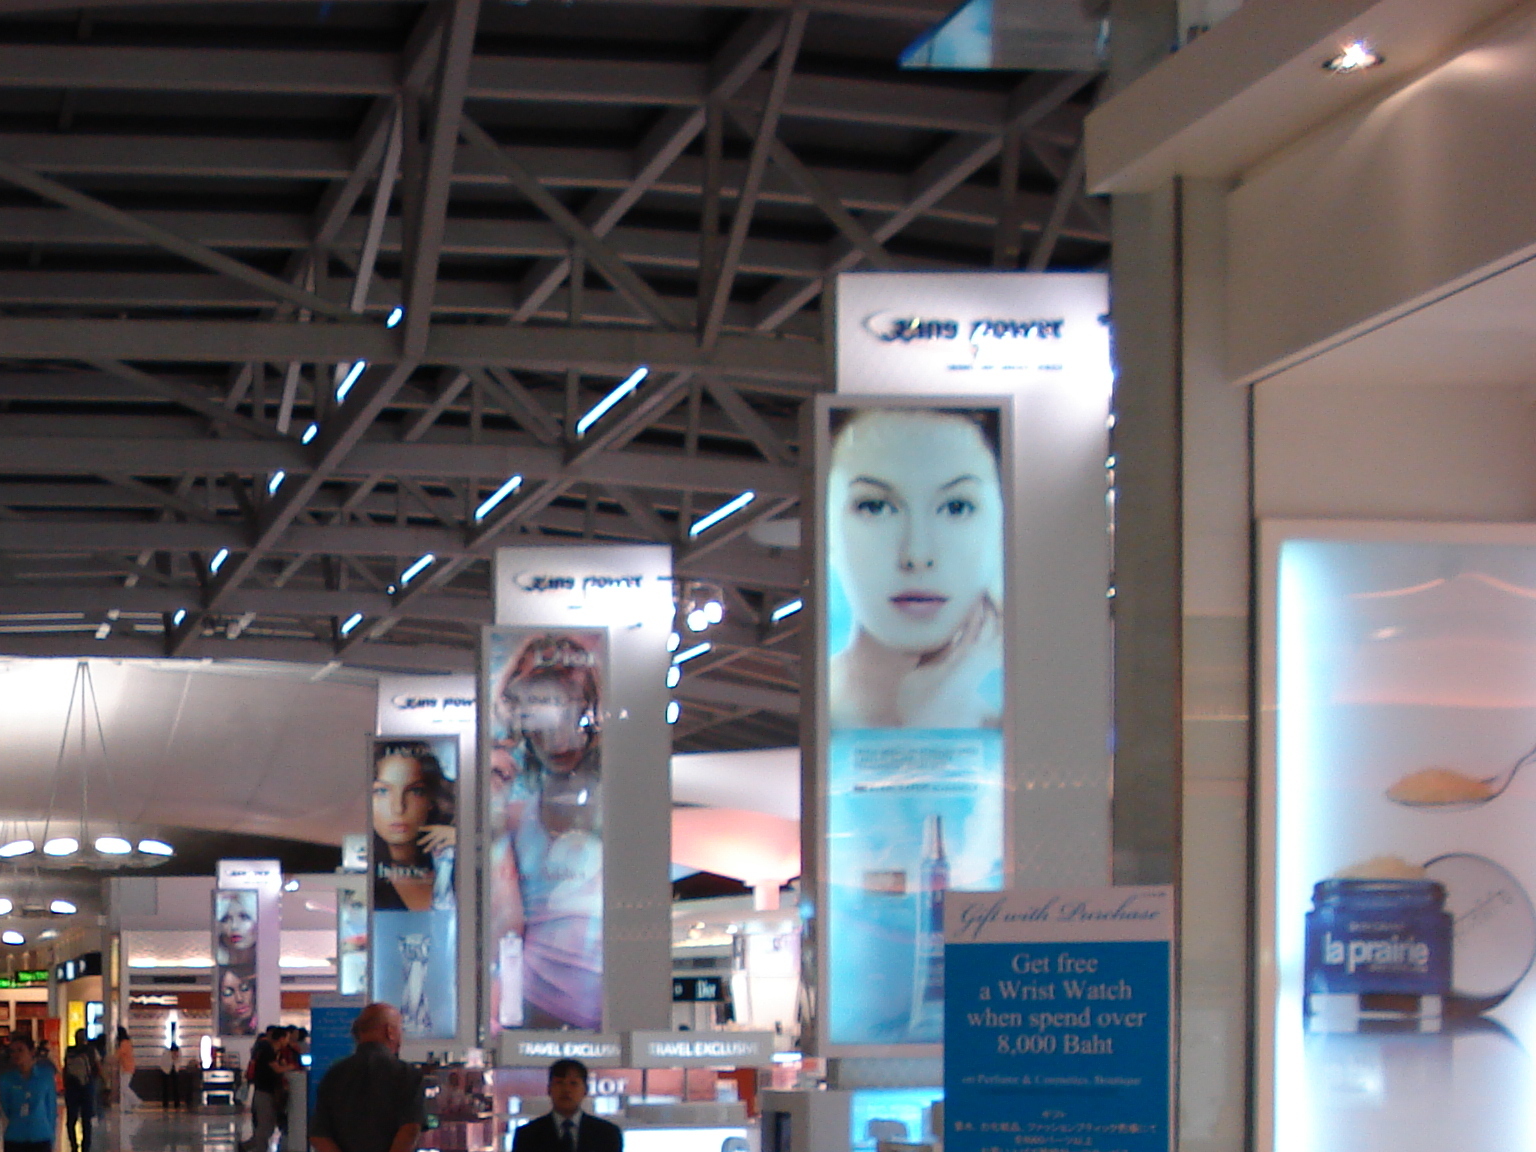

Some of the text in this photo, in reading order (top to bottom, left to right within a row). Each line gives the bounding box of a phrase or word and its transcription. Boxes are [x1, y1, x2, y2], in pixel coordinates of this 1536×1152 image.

[954, 893, 1161, 939] Gift with Purchase
[1011, 952, 1099, 974] Get free
[1323, 931, 1430, 974] la prairie
[979, 979, 1133, 1001] a Wrist Watch
[967, 1006, 1147, 1033] when spend over
[519, 1041, 561, 1058] TRAVEL
[997, 1034, 1114, 1056] 8,000 Baht
[588, 1072, 630, 1096] ior
